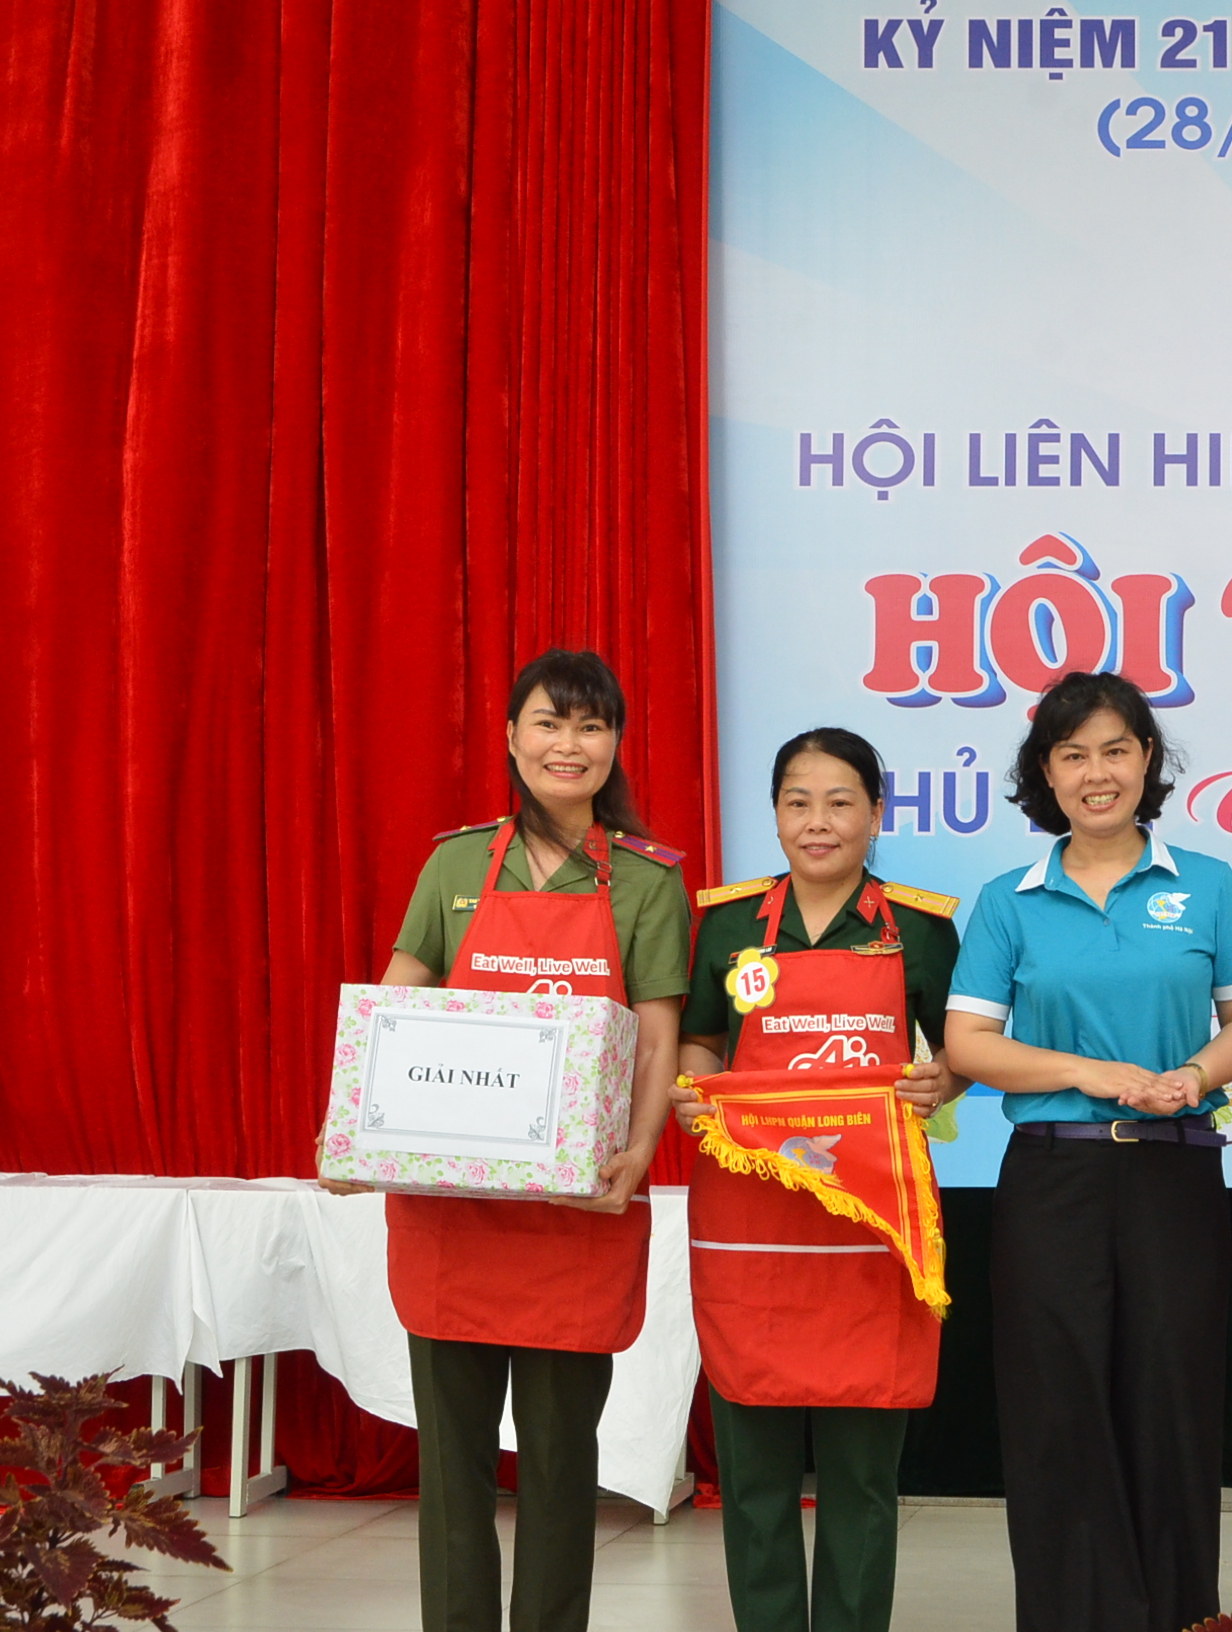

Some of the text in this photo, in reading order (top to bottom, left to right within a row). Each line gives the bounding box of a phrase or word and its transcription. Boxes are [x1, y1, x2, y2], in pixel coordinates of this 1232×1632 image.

[863, 0, 945, 69] KỶ
[968, 8, 1136, 80] NIỆM
[1160, 18, 1229, 69] 21
[800, 418, 937, 501] HỘI
[969, 418, 1121, 488] LIÊN
[864, 532, 1195, 722] HỘI
[878, 745, 989, 834] HỦ
[472, 954, 498, 971] Eat
[500, 957, 536, 976] Well,
[538, 958, 572, 975] Live
[741, 967, 766, 996] 15
[762, 1016, 790, 1033] Eat
[790, 1015, 830, 1033] Well,
[832, 1014, 866, 1031] Live
[408, 1063, 520, 1089] GIẢI NHẤT
[741, 1113, 872, 1130] HỘI LHPN QUẬN LONG BIÊN
